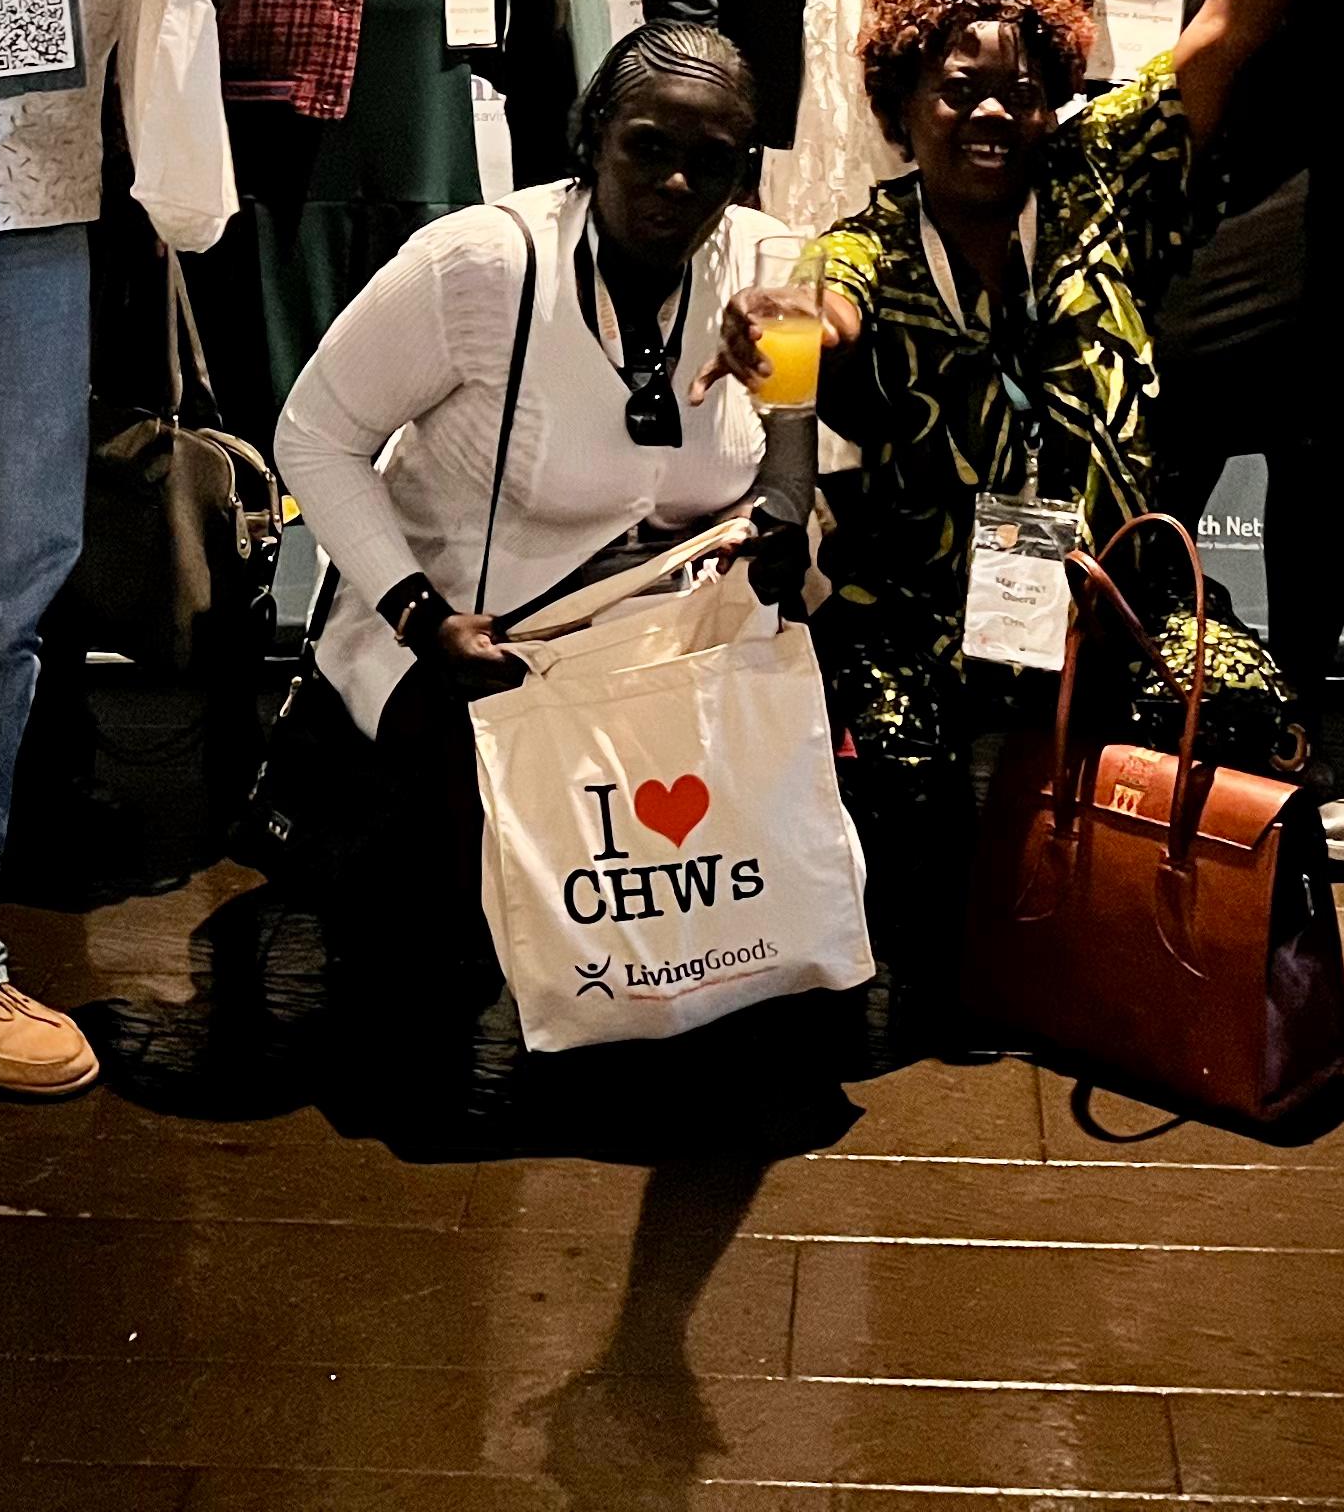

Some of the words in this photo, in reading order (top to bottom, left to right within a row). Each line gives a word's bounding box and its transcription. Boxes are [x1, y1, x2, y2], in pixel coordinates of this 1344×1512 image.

[584, 784, 629, 861] I
[563, 854, 765, 925] CHWs
[625, 939, 779, 987] LivingGoods
